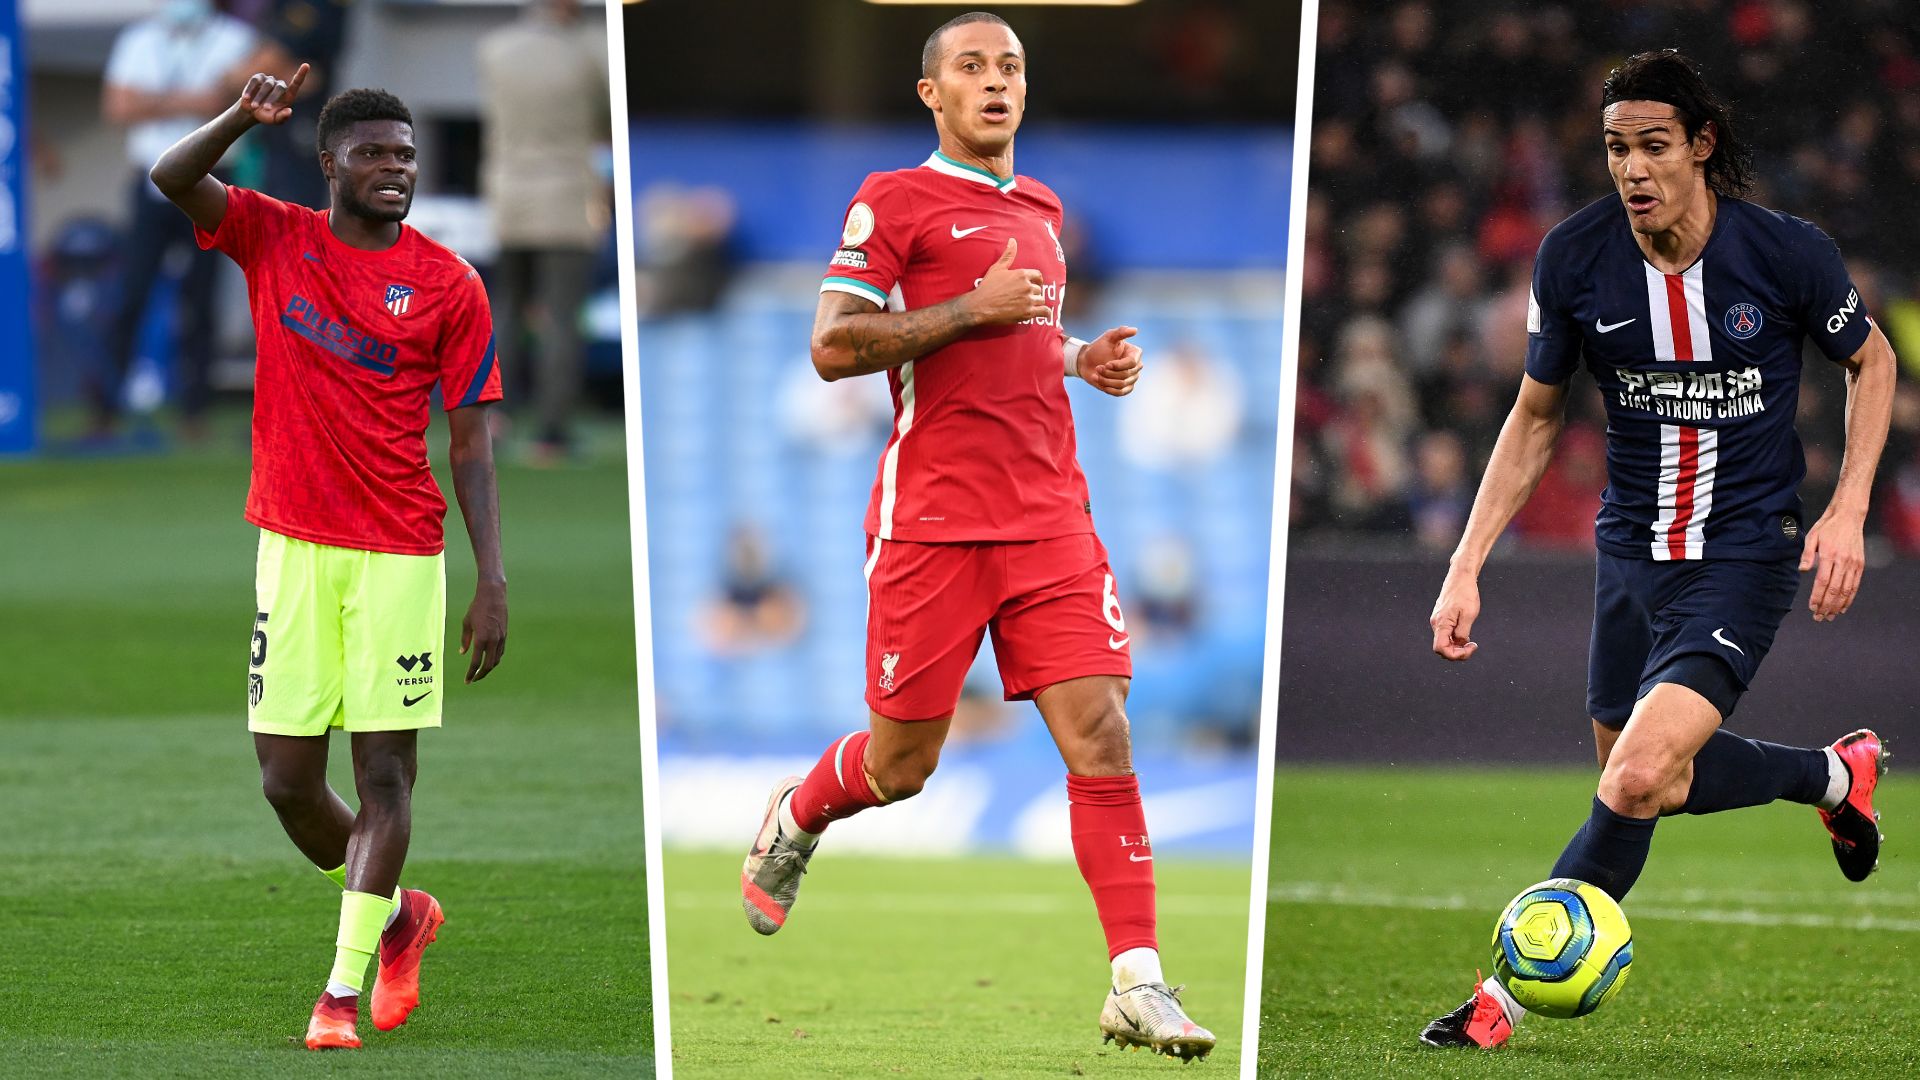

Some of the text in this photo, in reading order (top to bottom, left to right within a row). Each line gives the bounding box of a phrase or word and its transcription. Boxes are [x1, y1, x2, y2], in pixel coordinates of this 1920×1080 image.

[1729, 304, 1755, 315] PARIS
[1826, 287, 1859, 334] QNB
[1619, 391, 1766, 421] STAY STRONG CHINA
[1102, 573, 1126, 633] 6
[396, 675, 434, 686] VERSUS
